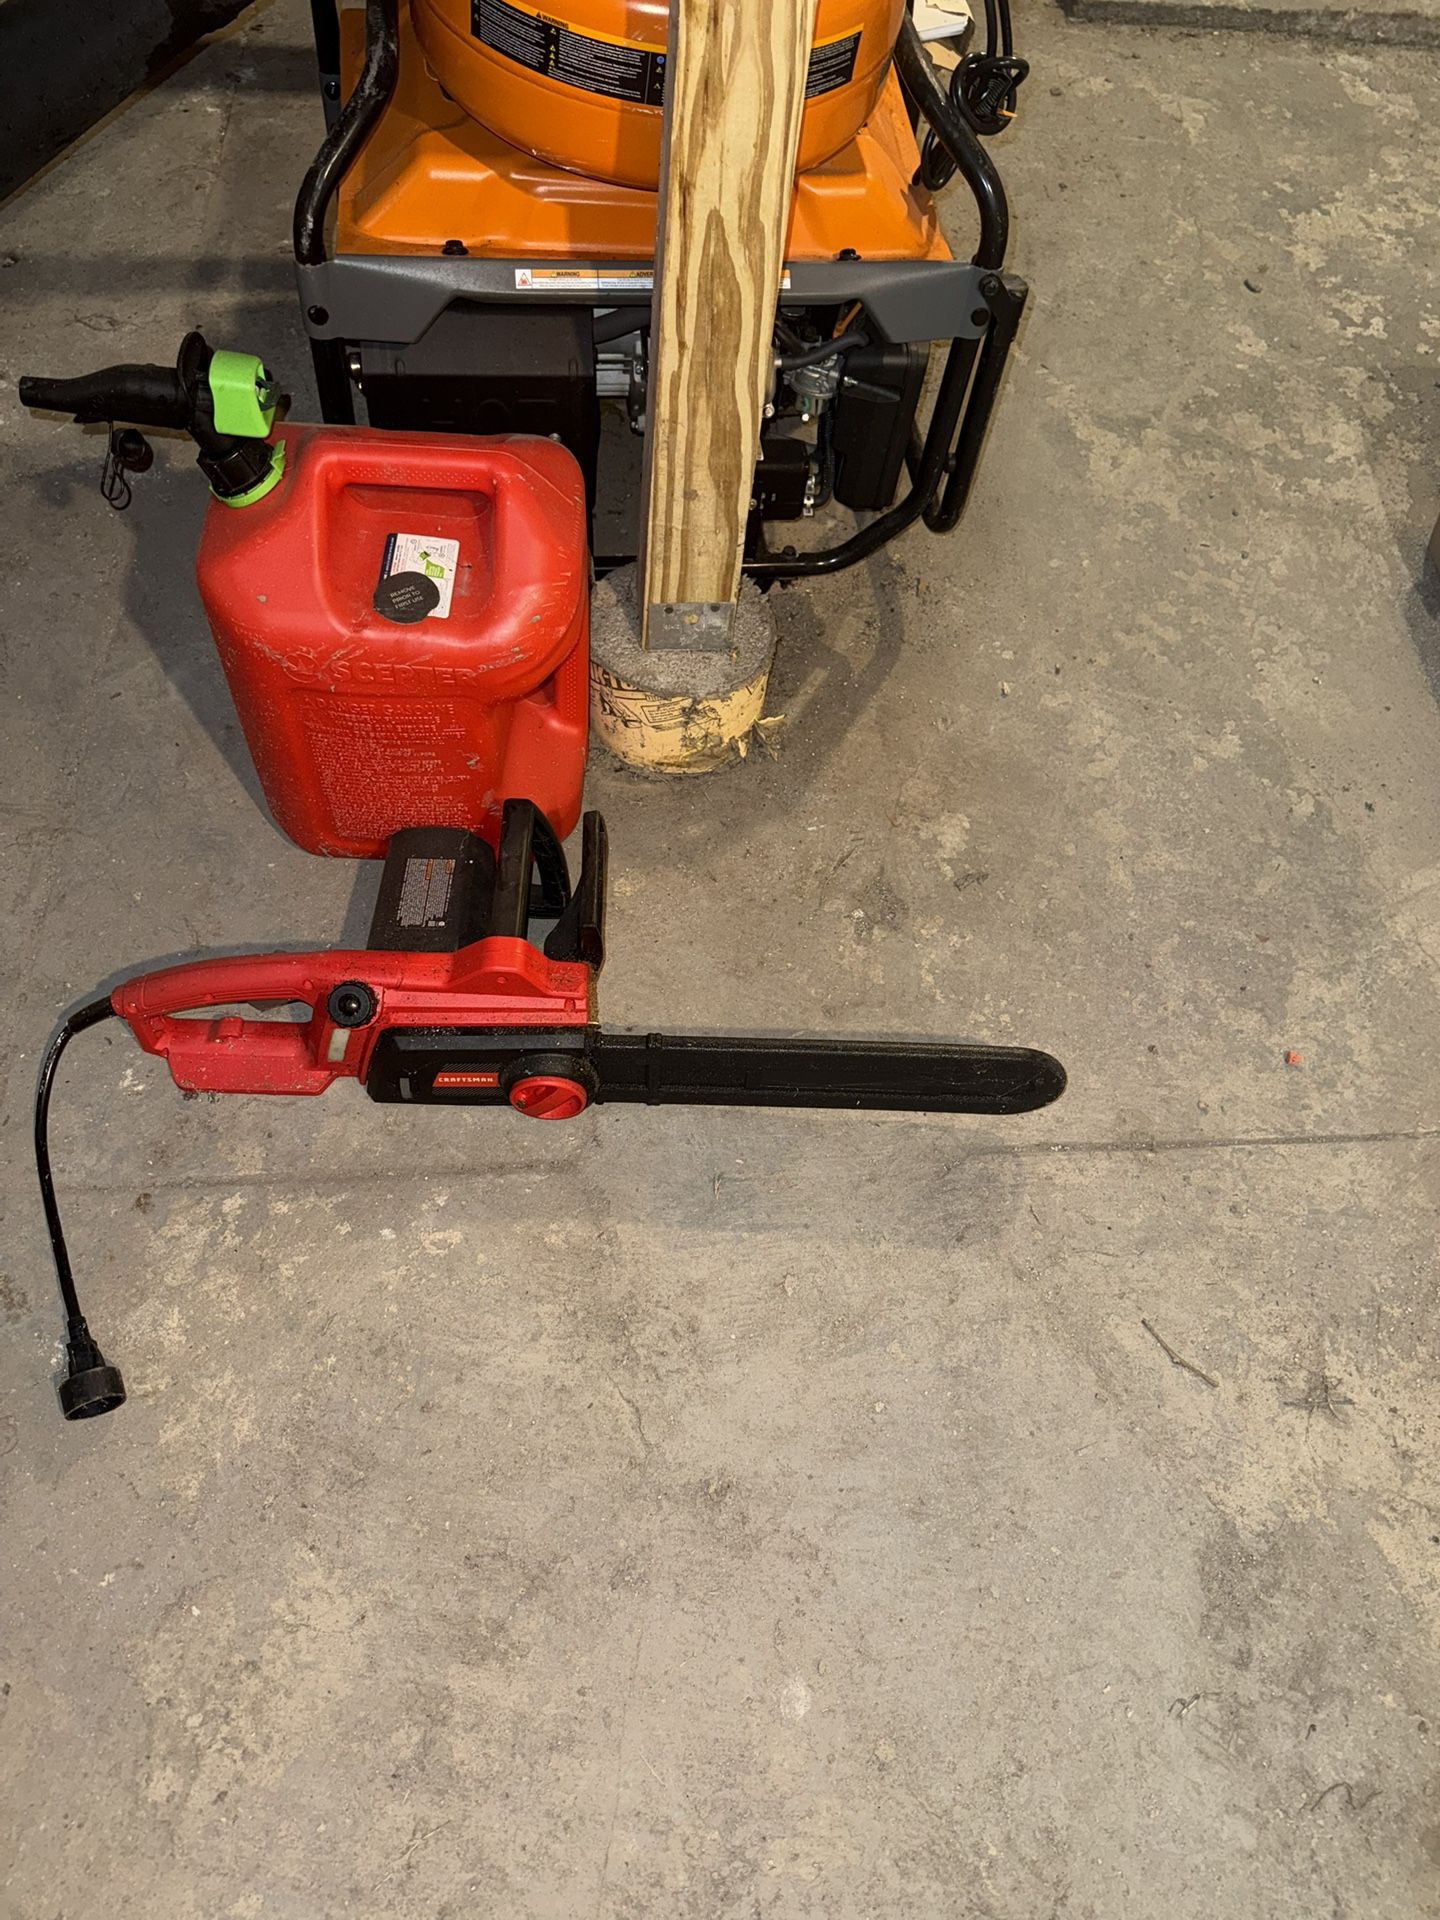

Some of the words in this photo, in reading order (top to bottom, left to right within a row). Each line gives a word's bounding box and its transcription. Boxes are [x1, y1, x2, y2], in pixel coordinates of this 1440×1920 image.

[390, 586, 415, 597] REMOVE
[392, 593, 411, 604] PRIOR
[395, 599, 411, 609] FIRST
[412, 595, 424, 603] USE
[331, 660, 477, 687] SCEPTER
